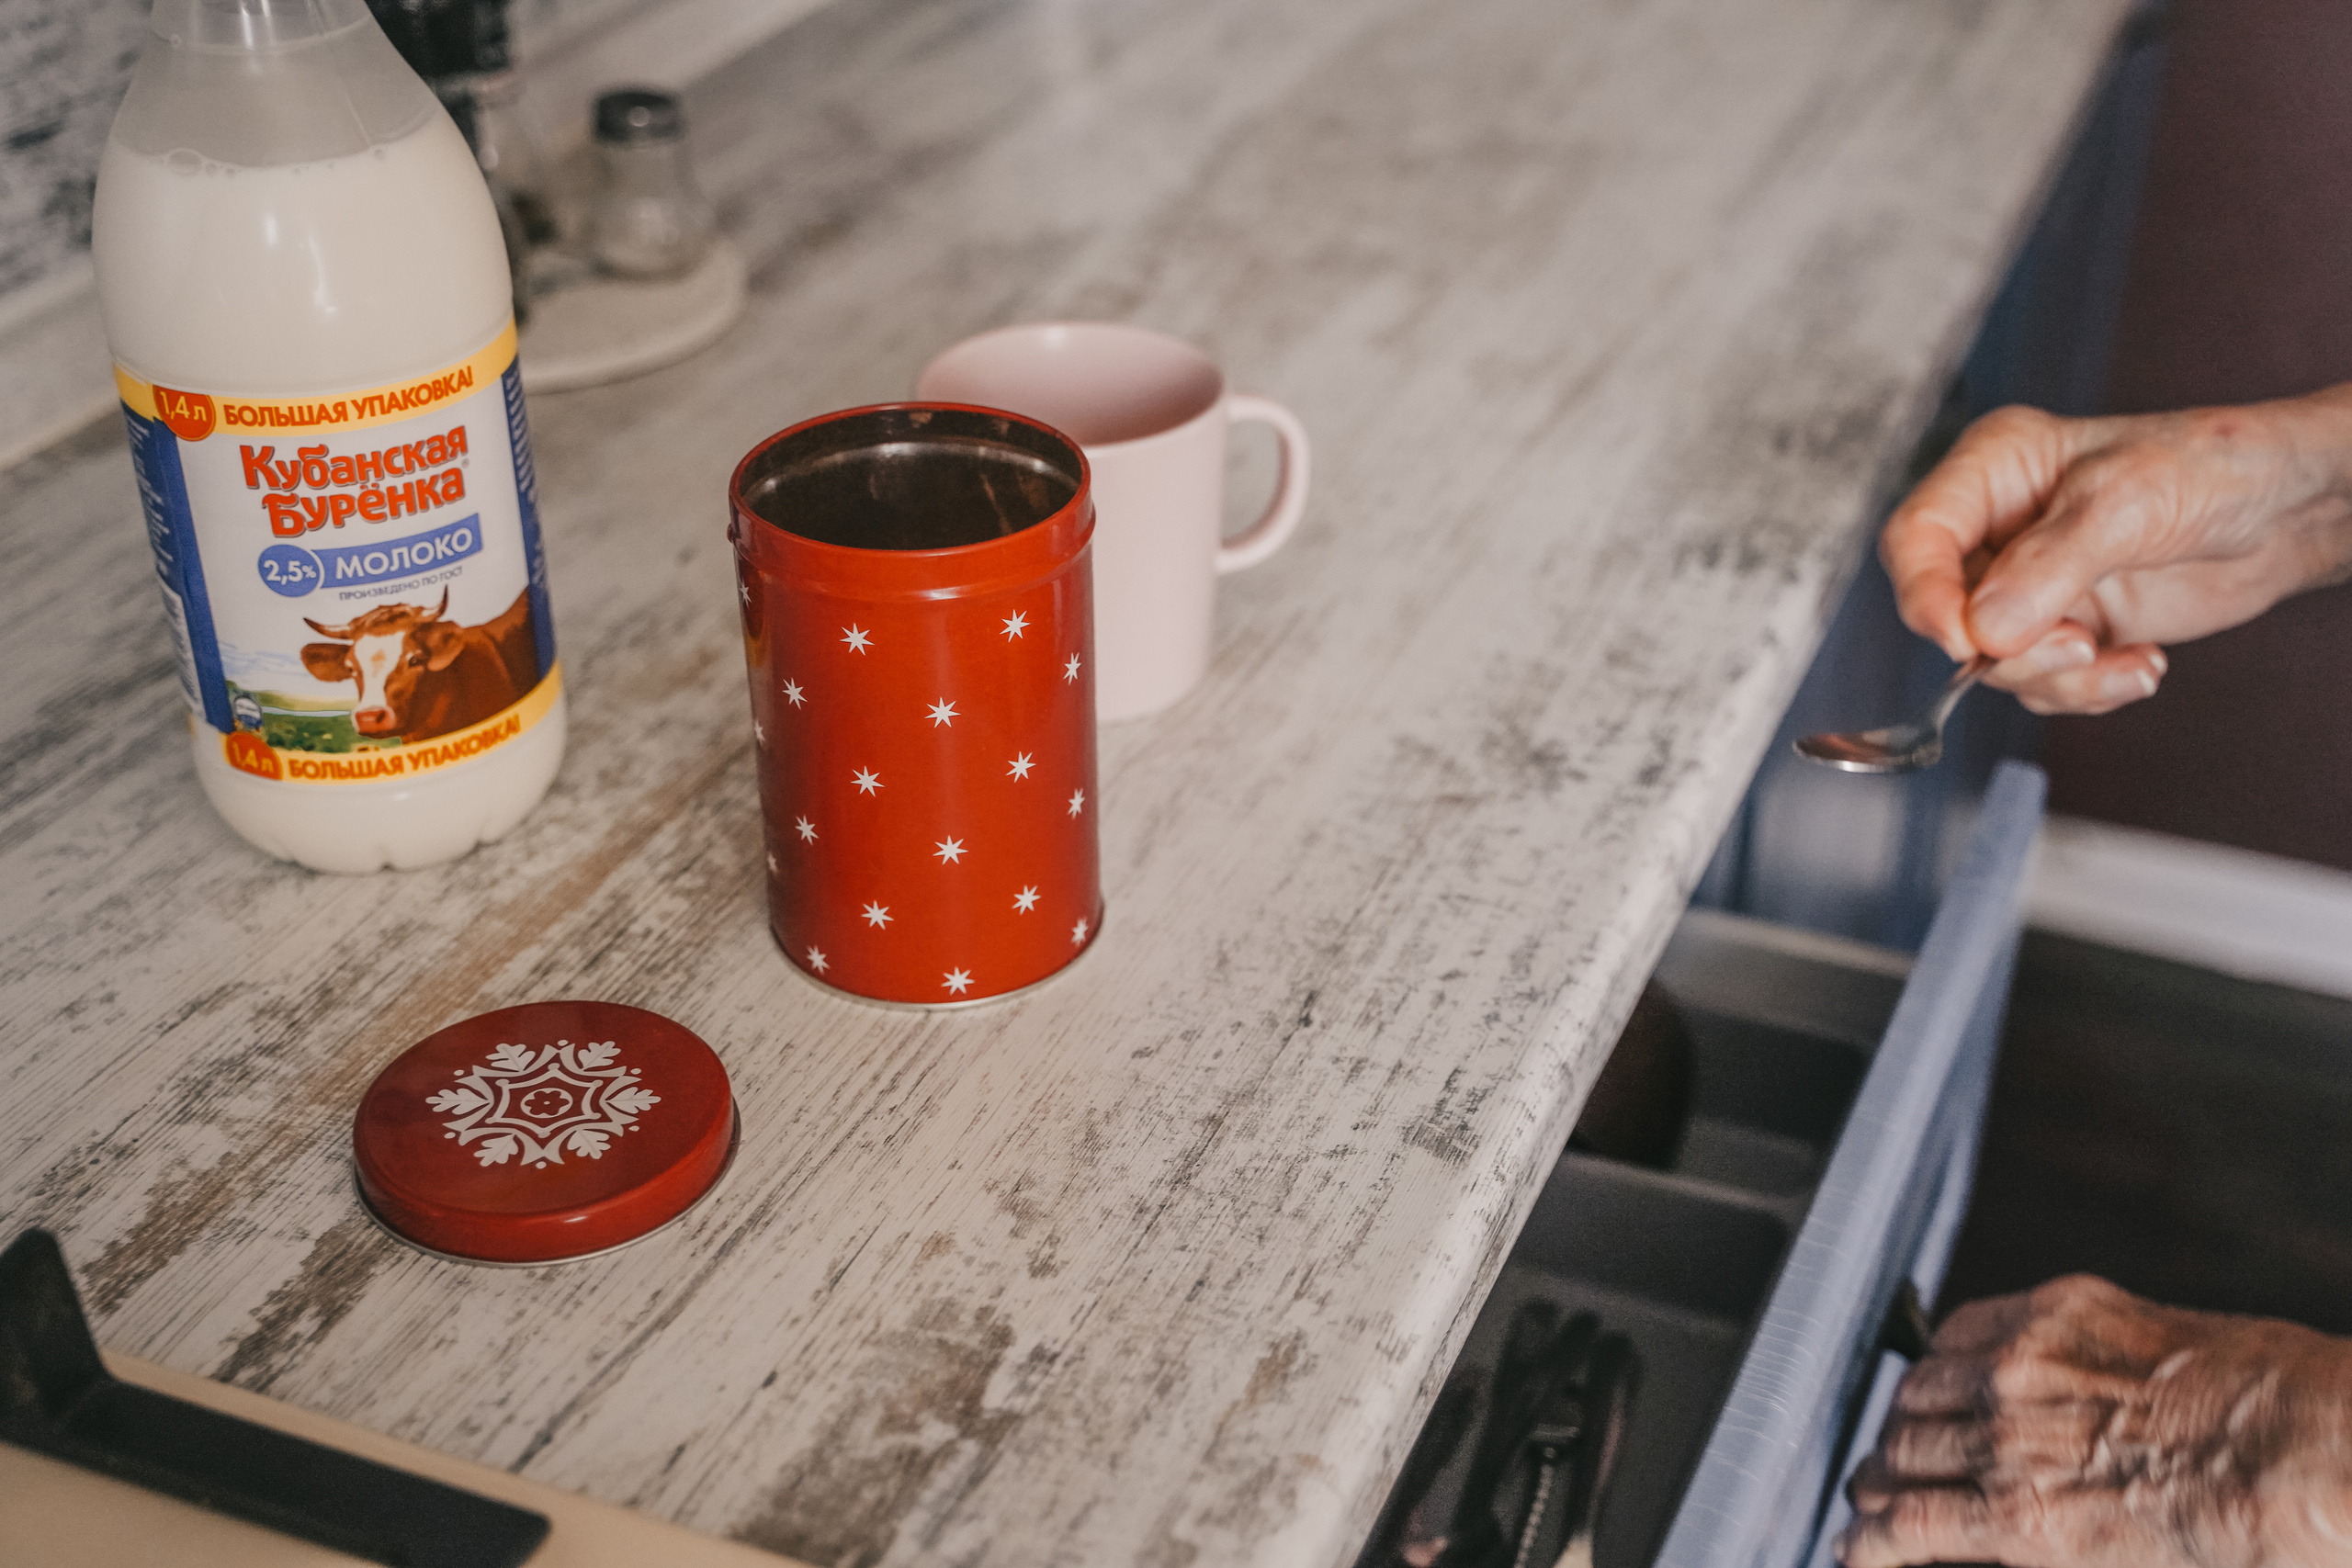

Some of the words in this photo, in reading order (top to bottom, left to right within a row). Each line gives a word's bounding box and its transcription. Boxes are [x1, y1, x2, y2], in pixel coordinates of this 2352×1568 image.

[223, 400, 349, 427] БОЛЬШАЯ
[350, 365, 474, 420] УПАКОВКА!
[239, 425, 469, 492] Кубанская
[261, 467, 466, 538] Бурёнка
[264, 559, 317, 585] 2,5%
[335, 526, 473, 580] МОЛОКО
[339, 580, 421, 601] ПРОИЗВЕДЕНО
[422, 575, 438, 587] ПО
[439, 566, 463, 581] ГОСТ
[288, 754, 404, 780] БОЛЬШАЯ
[406, 714, 521, 771] УПАКОВКА!
